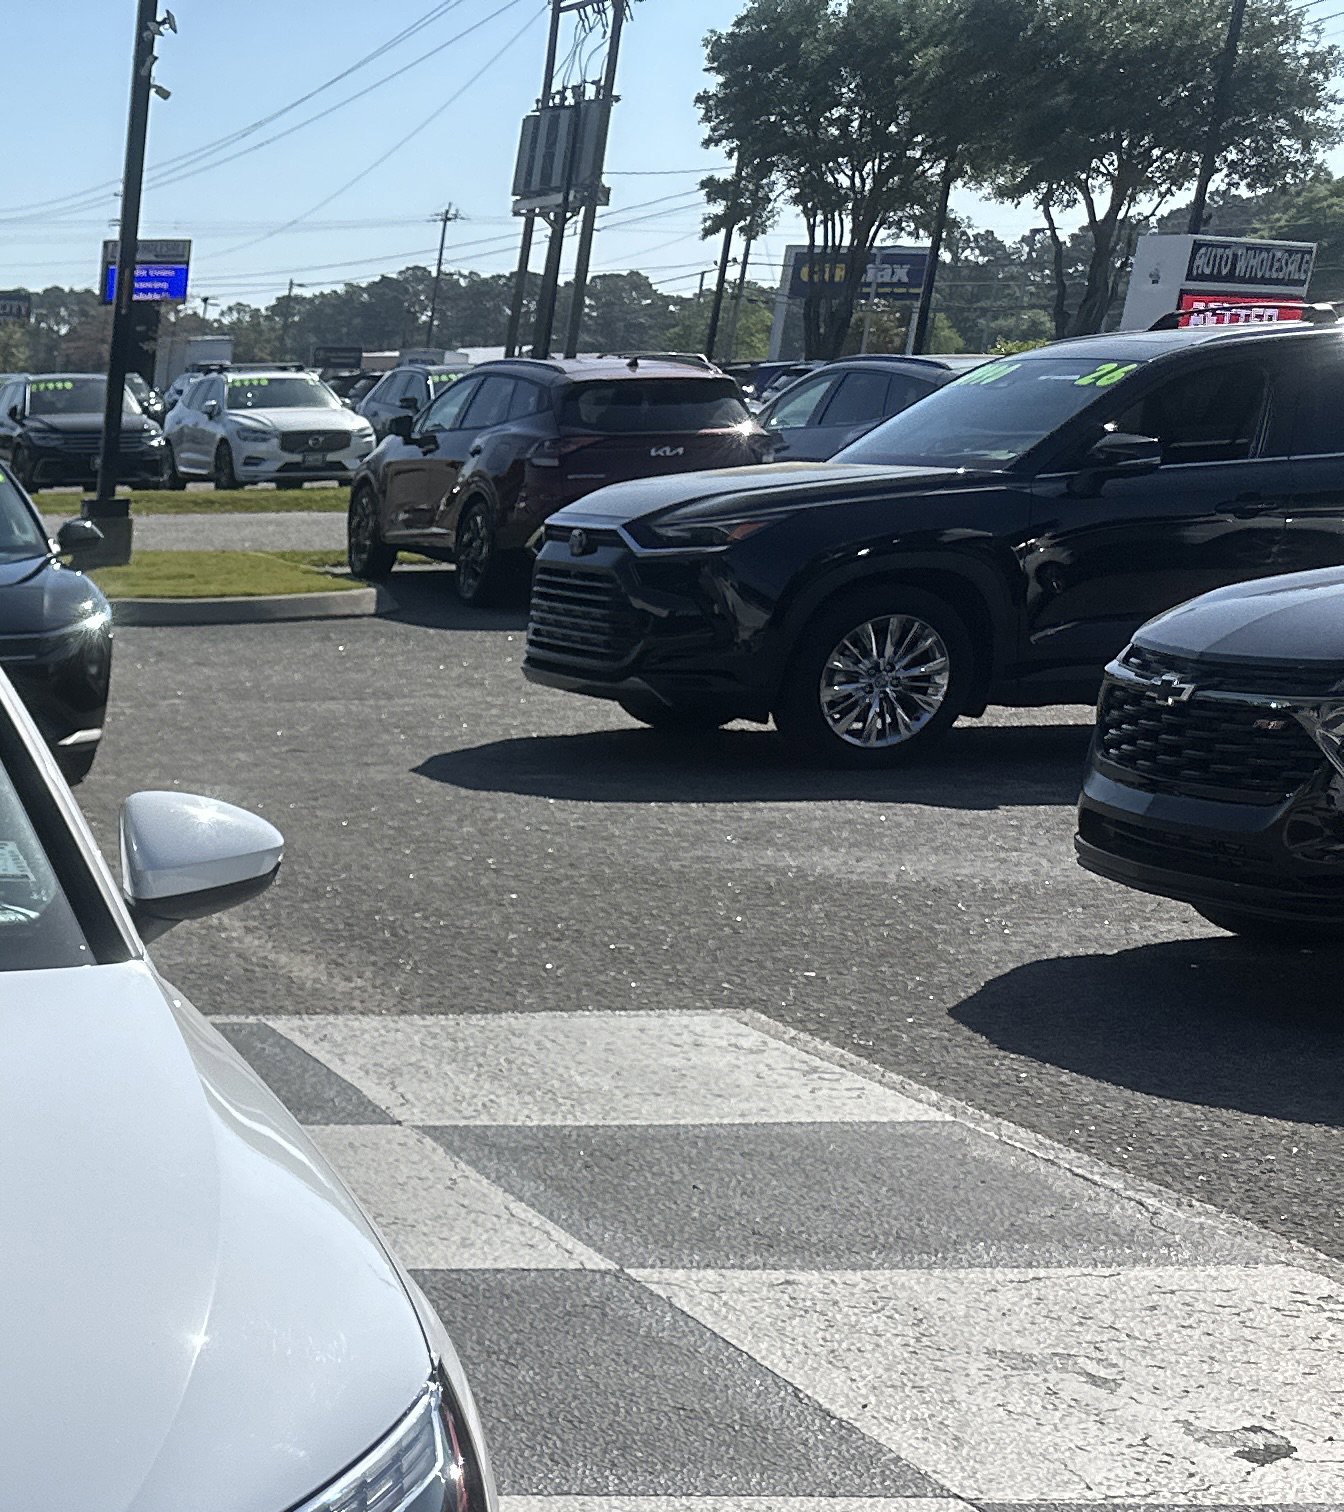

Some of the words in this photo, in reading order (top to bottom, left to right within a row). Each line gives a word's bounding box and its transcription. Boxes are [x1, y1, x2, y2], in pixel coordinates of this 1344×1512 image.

[1192, 246, 1233, 277] AUTO
[1234, 247, 1313, 280] WHOLESALE
[1073, 363, 1139, 387] 26
